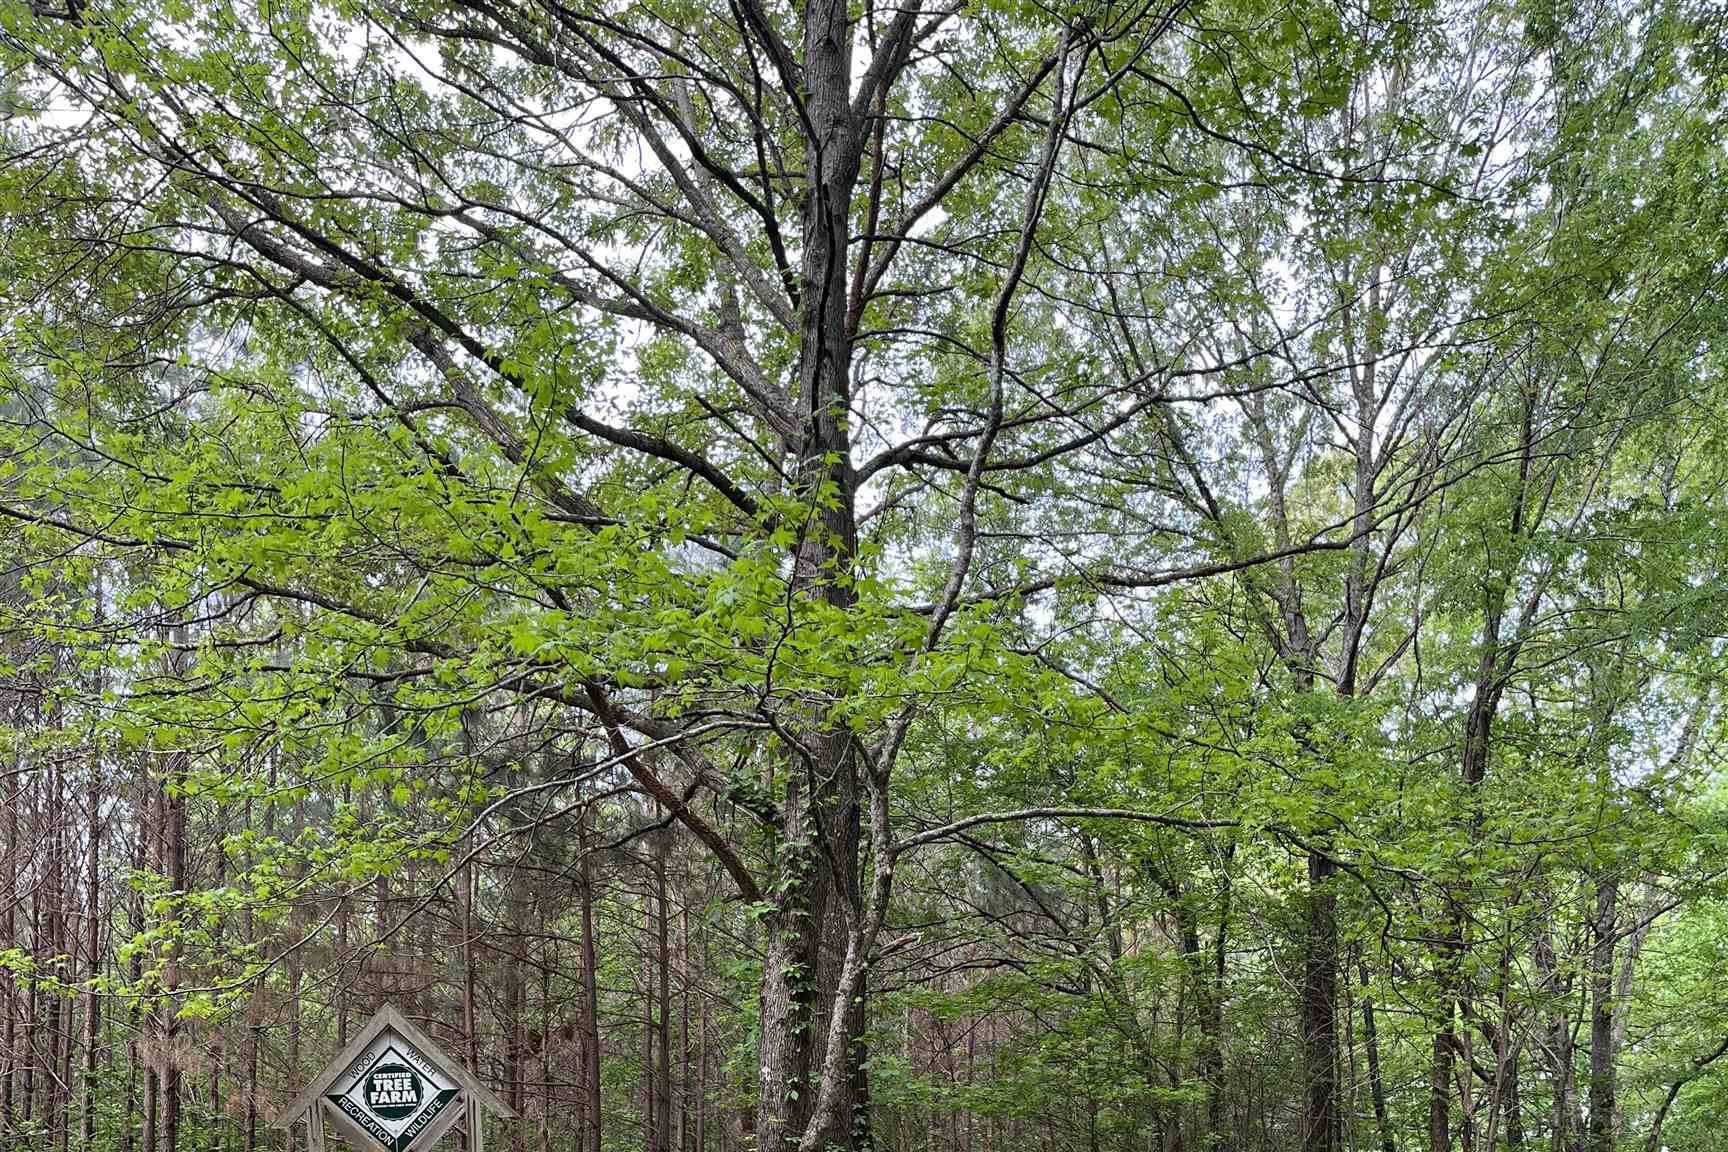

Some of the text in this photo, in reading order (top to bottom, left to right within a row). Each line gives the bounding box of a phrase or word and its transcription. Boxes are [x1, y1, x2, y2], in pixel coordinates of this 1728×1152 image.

[350, 1051, 376, 1080] WOOD
[406, 1048, 435, 1076] WATER
[370, 1090, 417, 1104] FARM
[373, 1079, 412, 1091] TREE
[338, 1097, 395, 1146] RECREATION
[404, 1098, 444, 1137] WILDLIFE
